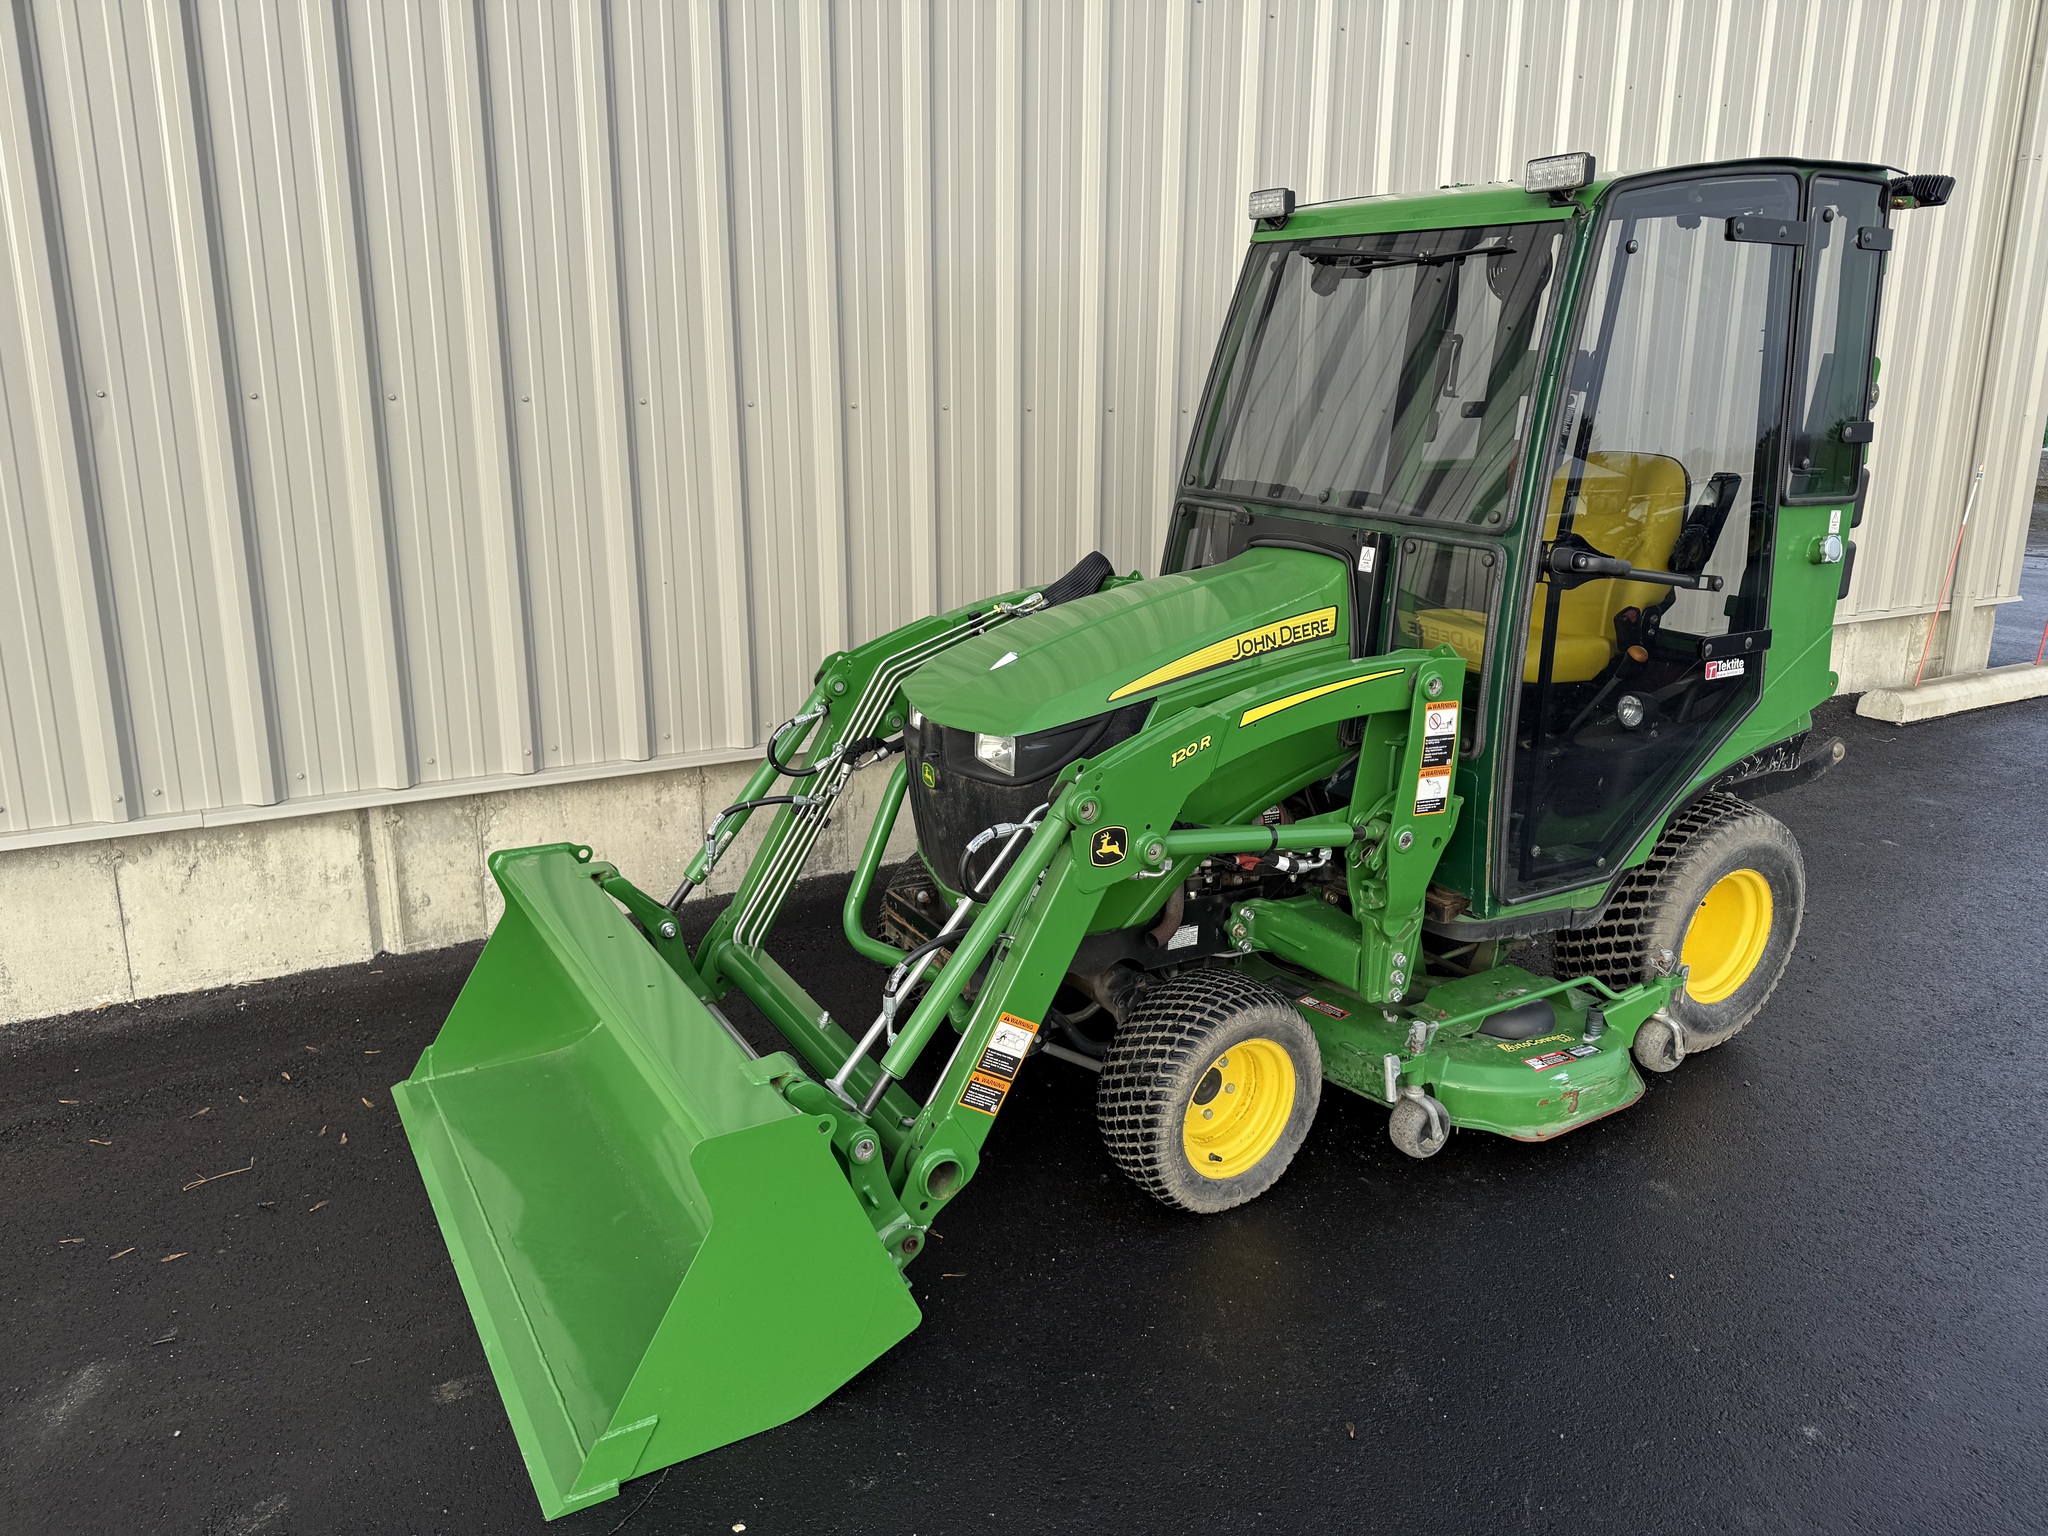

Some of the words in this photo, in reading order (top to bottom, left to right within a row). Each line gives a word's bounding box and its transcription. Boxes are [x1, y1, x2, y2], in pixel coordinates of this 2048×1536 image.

[1232, 631, 1277, 659] JOHN
[1279, 618, 1330, 643] DEERE
[1717, 658, 1744, 671] Tektite
[1432, 702, 1457, 710] WARNING
[1425, 768, 1450, 777] WARNING
[1010, 1017, 1034, 1030] WARNING
[981, 1077, 1006, 1090] WARNING
